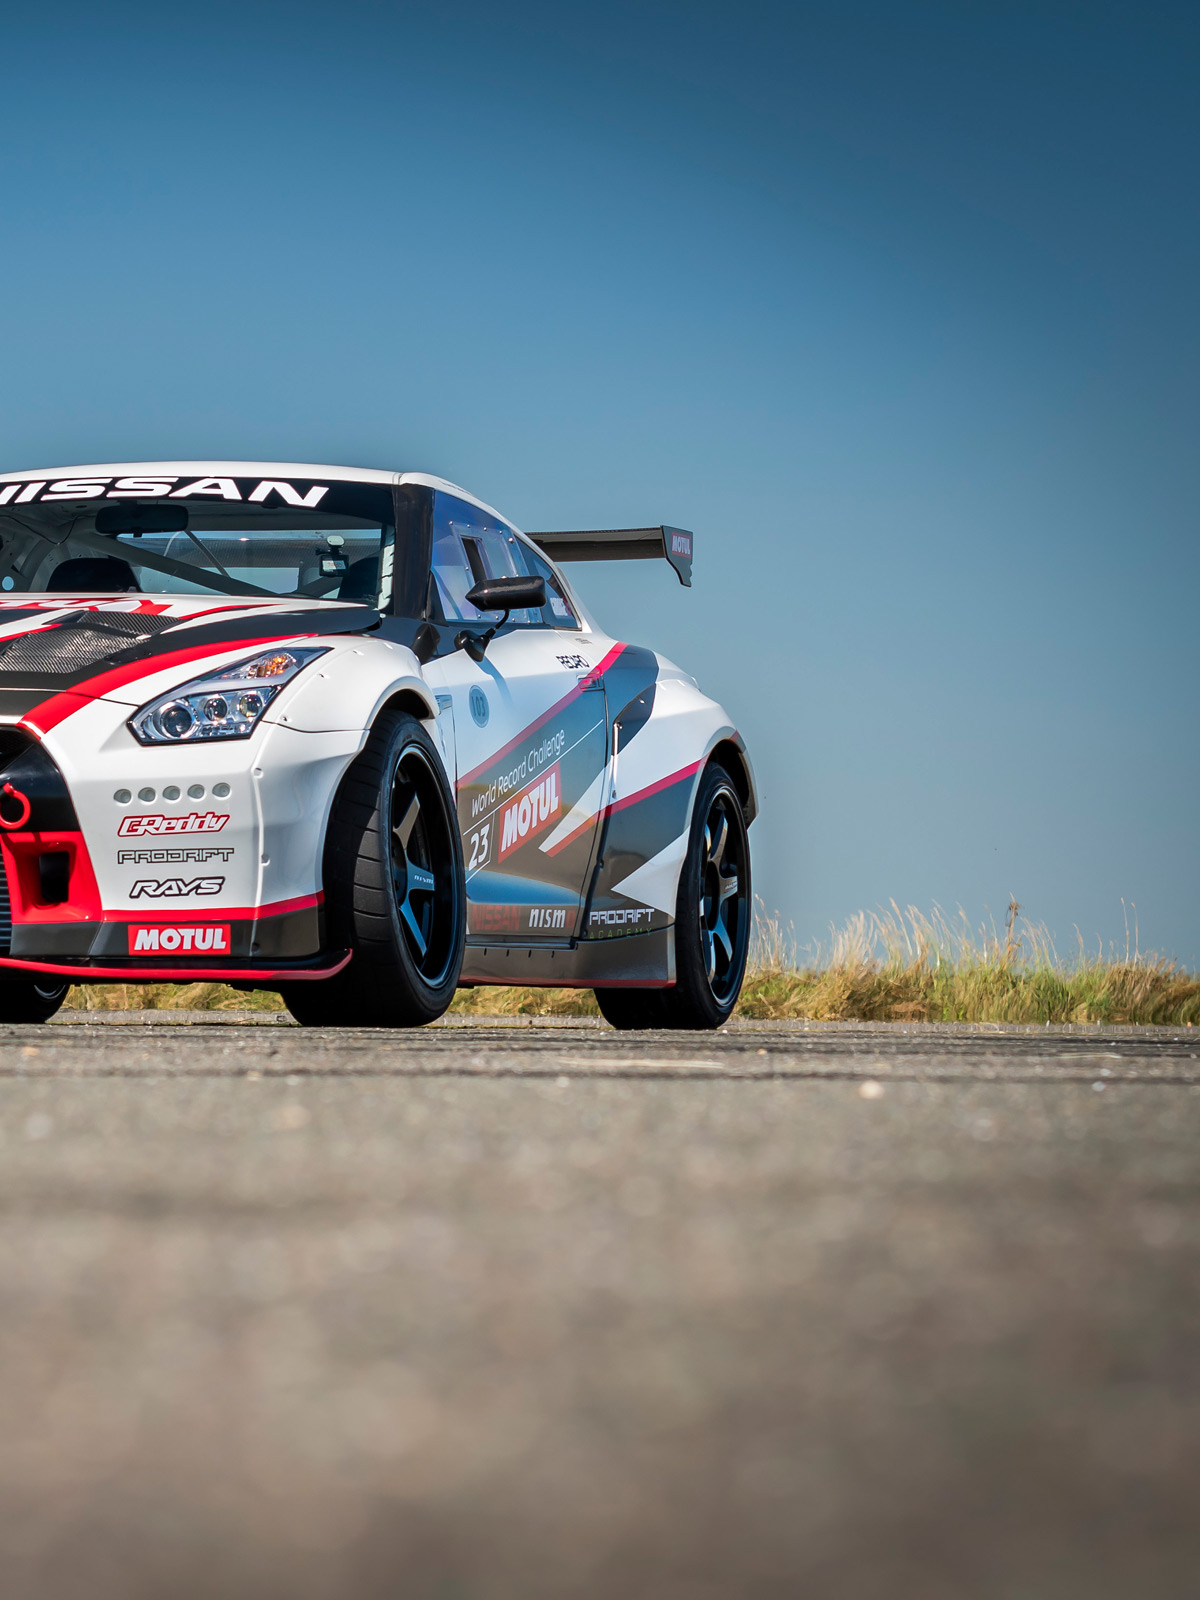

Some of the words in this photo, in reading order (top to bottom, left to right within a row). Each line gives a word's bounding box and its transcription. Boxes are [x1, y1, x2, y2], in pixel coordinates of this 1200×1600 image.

[672, 535, 691, 555] MOTUL
[471, 780, 497, 818] World
[497, 756, 527, 798] Record
[527, 729, 565, 772] Challenge
[117, 811, 230, 837] GReddy
[501, 772, 559, 853] MOTUL
[117, 847, 235, 864] PRODRIFT
[468, 823, 490, 871] 23
[129, 876, 226, 899] RAYS
[471, 904, 521, 931] NISSAN
[528, 908, 577, 928] nismo
[589, 909, 655, 926] PRODRIFT
[134, 928, 227, 951] MOTUL
[589, 928, 652, 939] ACADEMY
